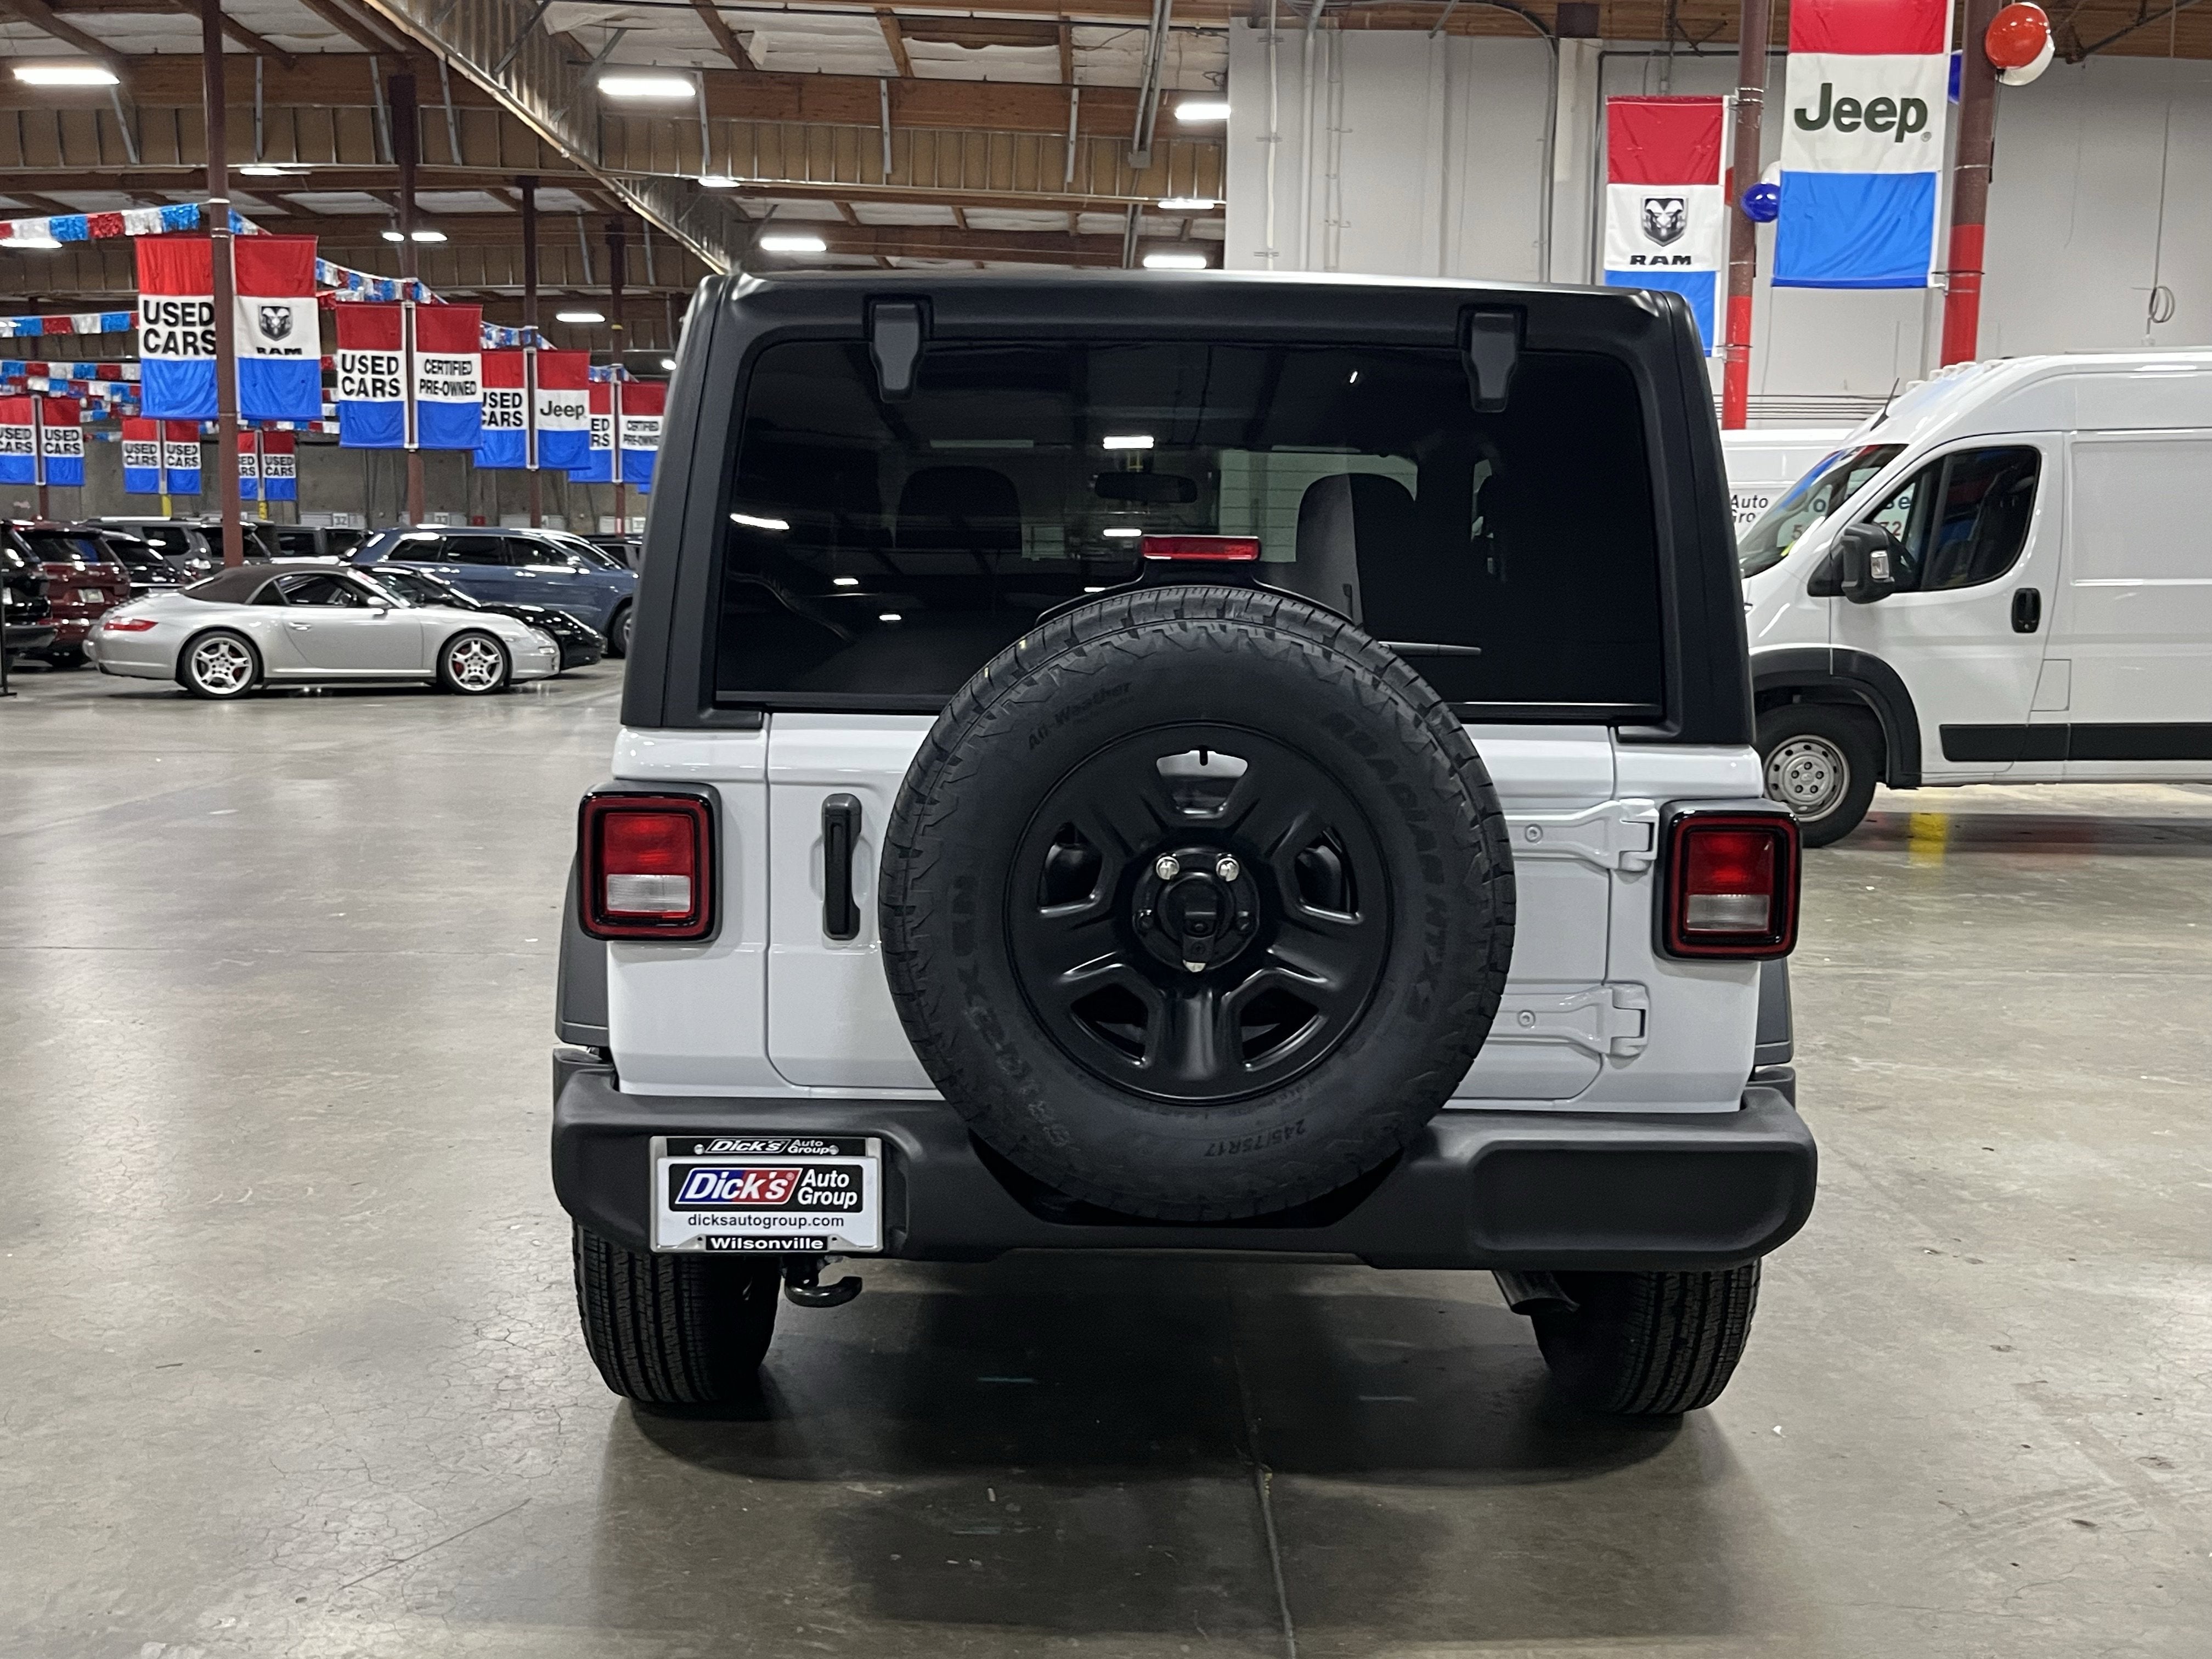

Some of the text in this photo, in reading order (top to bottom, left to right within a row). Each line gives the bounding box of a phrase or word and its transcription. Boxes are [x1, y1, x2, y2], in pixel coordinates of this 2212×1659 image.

[1794, 83, 1928, 143] Jeep
[1630, 255, 1692, 266] RAM
[143, 300, 215, 326] USED
[143, 328, 217, 355] CARS
[256, 347, 302, 355] RAM
[341, 354, 399, 375] USED
[424, 359, 472, 376] CERTIFIED
[342, 376, 401, 397] CARS
[419, 379, 477, 396] PRE-OWNED
[540, 400, 585, 420] Jeep
[44, 429, 80, 441] USED
[44, 443, 81, 454] CARS
[125, 443, 157, 454] USED
[166, 444, 198, 456] USED
[126, 455, 158, 466] CARS
[167, 456, 199, 467] CARS
[264, 456, 294, 466] USED
[265, 467, 294, 476] CARS
[1730, 494, 1769, 508] Auto
[794, 1139, 823, 1147] Auto
[1204, 1118, 1307, 1157] 245/75R17
[711, 1139, 782, 1151] Dick's
[787, 1146, 829, 1155] Group
[802, 1169, 849, 1187] Auto
[685, 1171, 787, 1199] Dick's
[797, 1187, 857, 1209] Group
[687, 1214, 844, 1229] dicksautogroup.com
[711, 1237, 823, 1250] Wilsonville
